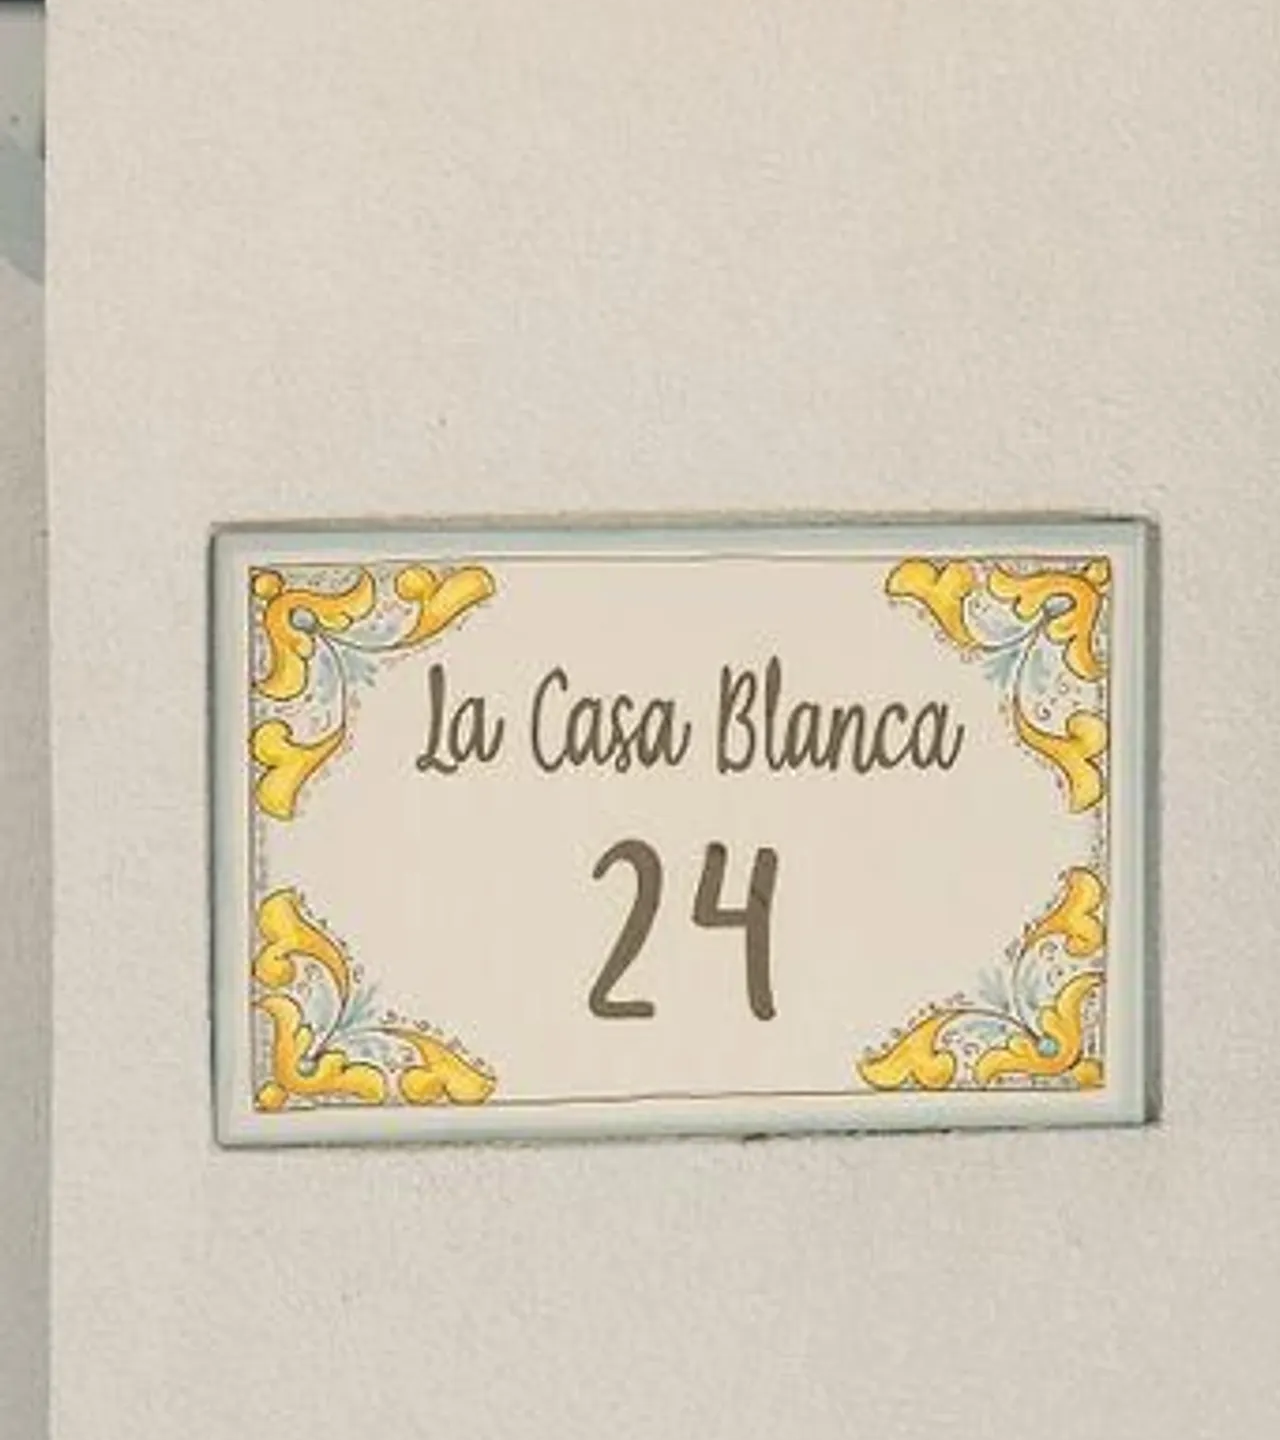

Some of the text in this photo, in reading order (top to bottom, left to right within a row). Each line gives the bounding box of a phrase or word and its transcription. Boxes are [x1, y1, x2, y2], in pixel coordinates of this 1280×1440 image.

[414, 656, 966, 775] La Casa Blanca
[588, 839, 779, 1022] 24
